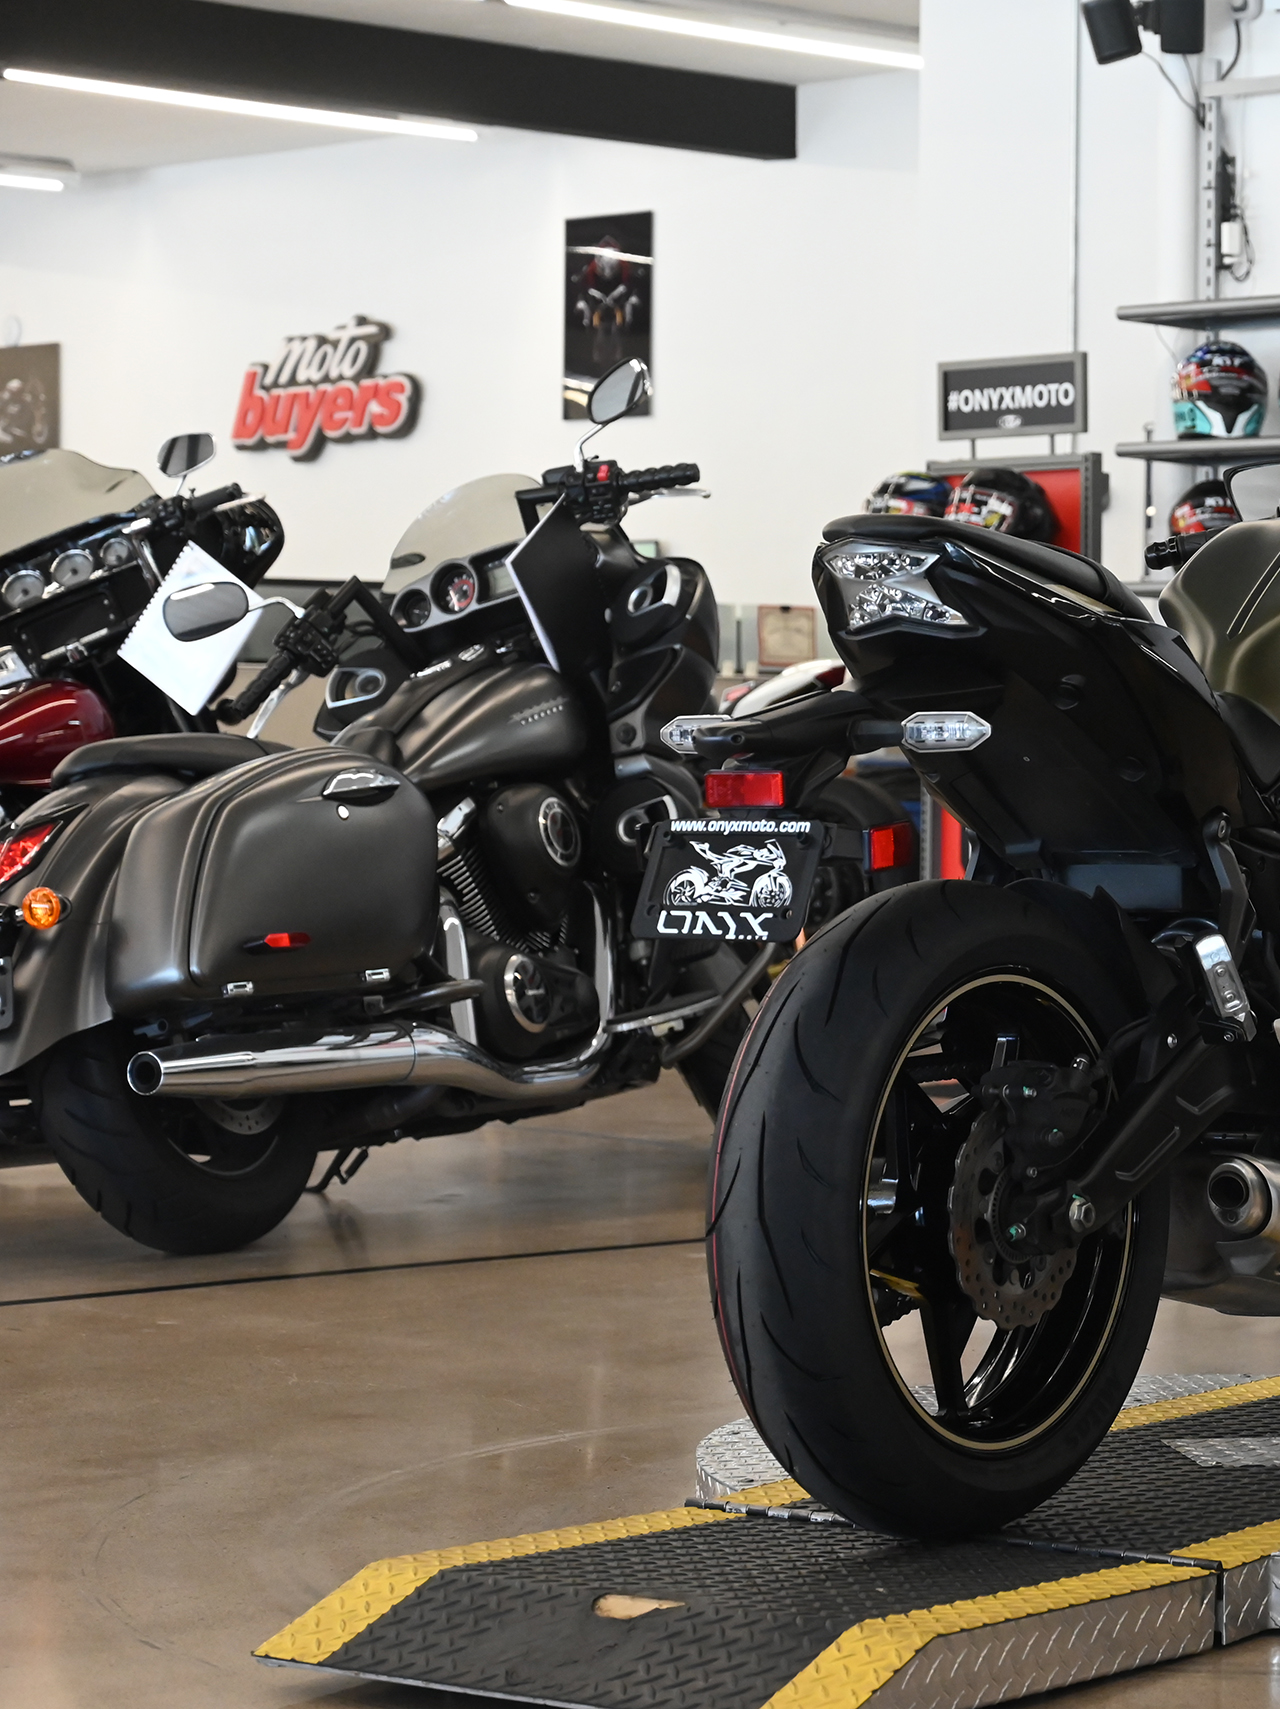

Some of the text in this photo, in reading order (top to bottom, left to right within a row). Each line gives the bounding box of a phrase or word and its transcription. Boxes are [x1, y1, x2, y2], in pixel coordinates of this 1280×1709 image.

[262, 322, 379, 386] Moto
[231, 366, 412, 456] buyers
[947, 382, 1075, 413] #ONYXMOTO
[670, 819, 811, 836] www.onyxmoto.com
[656, 910, 774, 940] ONYX
